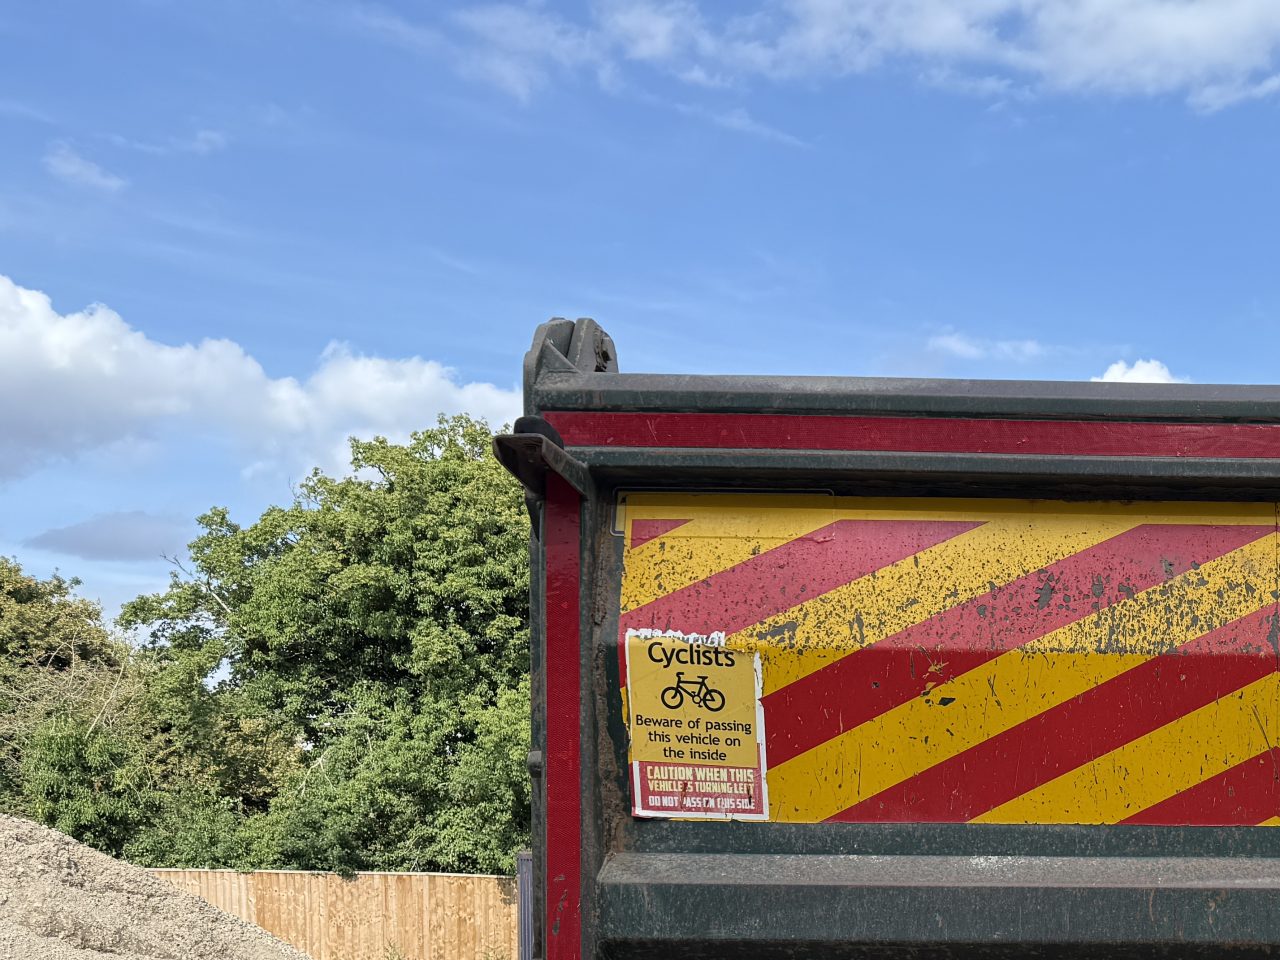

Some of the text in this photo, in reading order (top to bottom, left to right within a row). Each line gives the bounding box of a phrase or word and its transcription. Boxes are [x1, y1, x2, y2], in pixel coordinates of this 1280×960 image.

[647, 641, 736, 668] Cyclists
[635, 714, 752, 735] Beware of passing
[648, 731, 741, 747] this vehicle on
[663, 747, 727, 761] the inside
[646, 766, 754, 783] CAUTION WHEN THIS
[648, 780, 683, 792] VEHICLE
[694, 781, 733, 794] TURNING
[648, 795, 661, 807] DO
[661, 796, 679, 807] NOT
[682, 797, 701, 808] ASS
